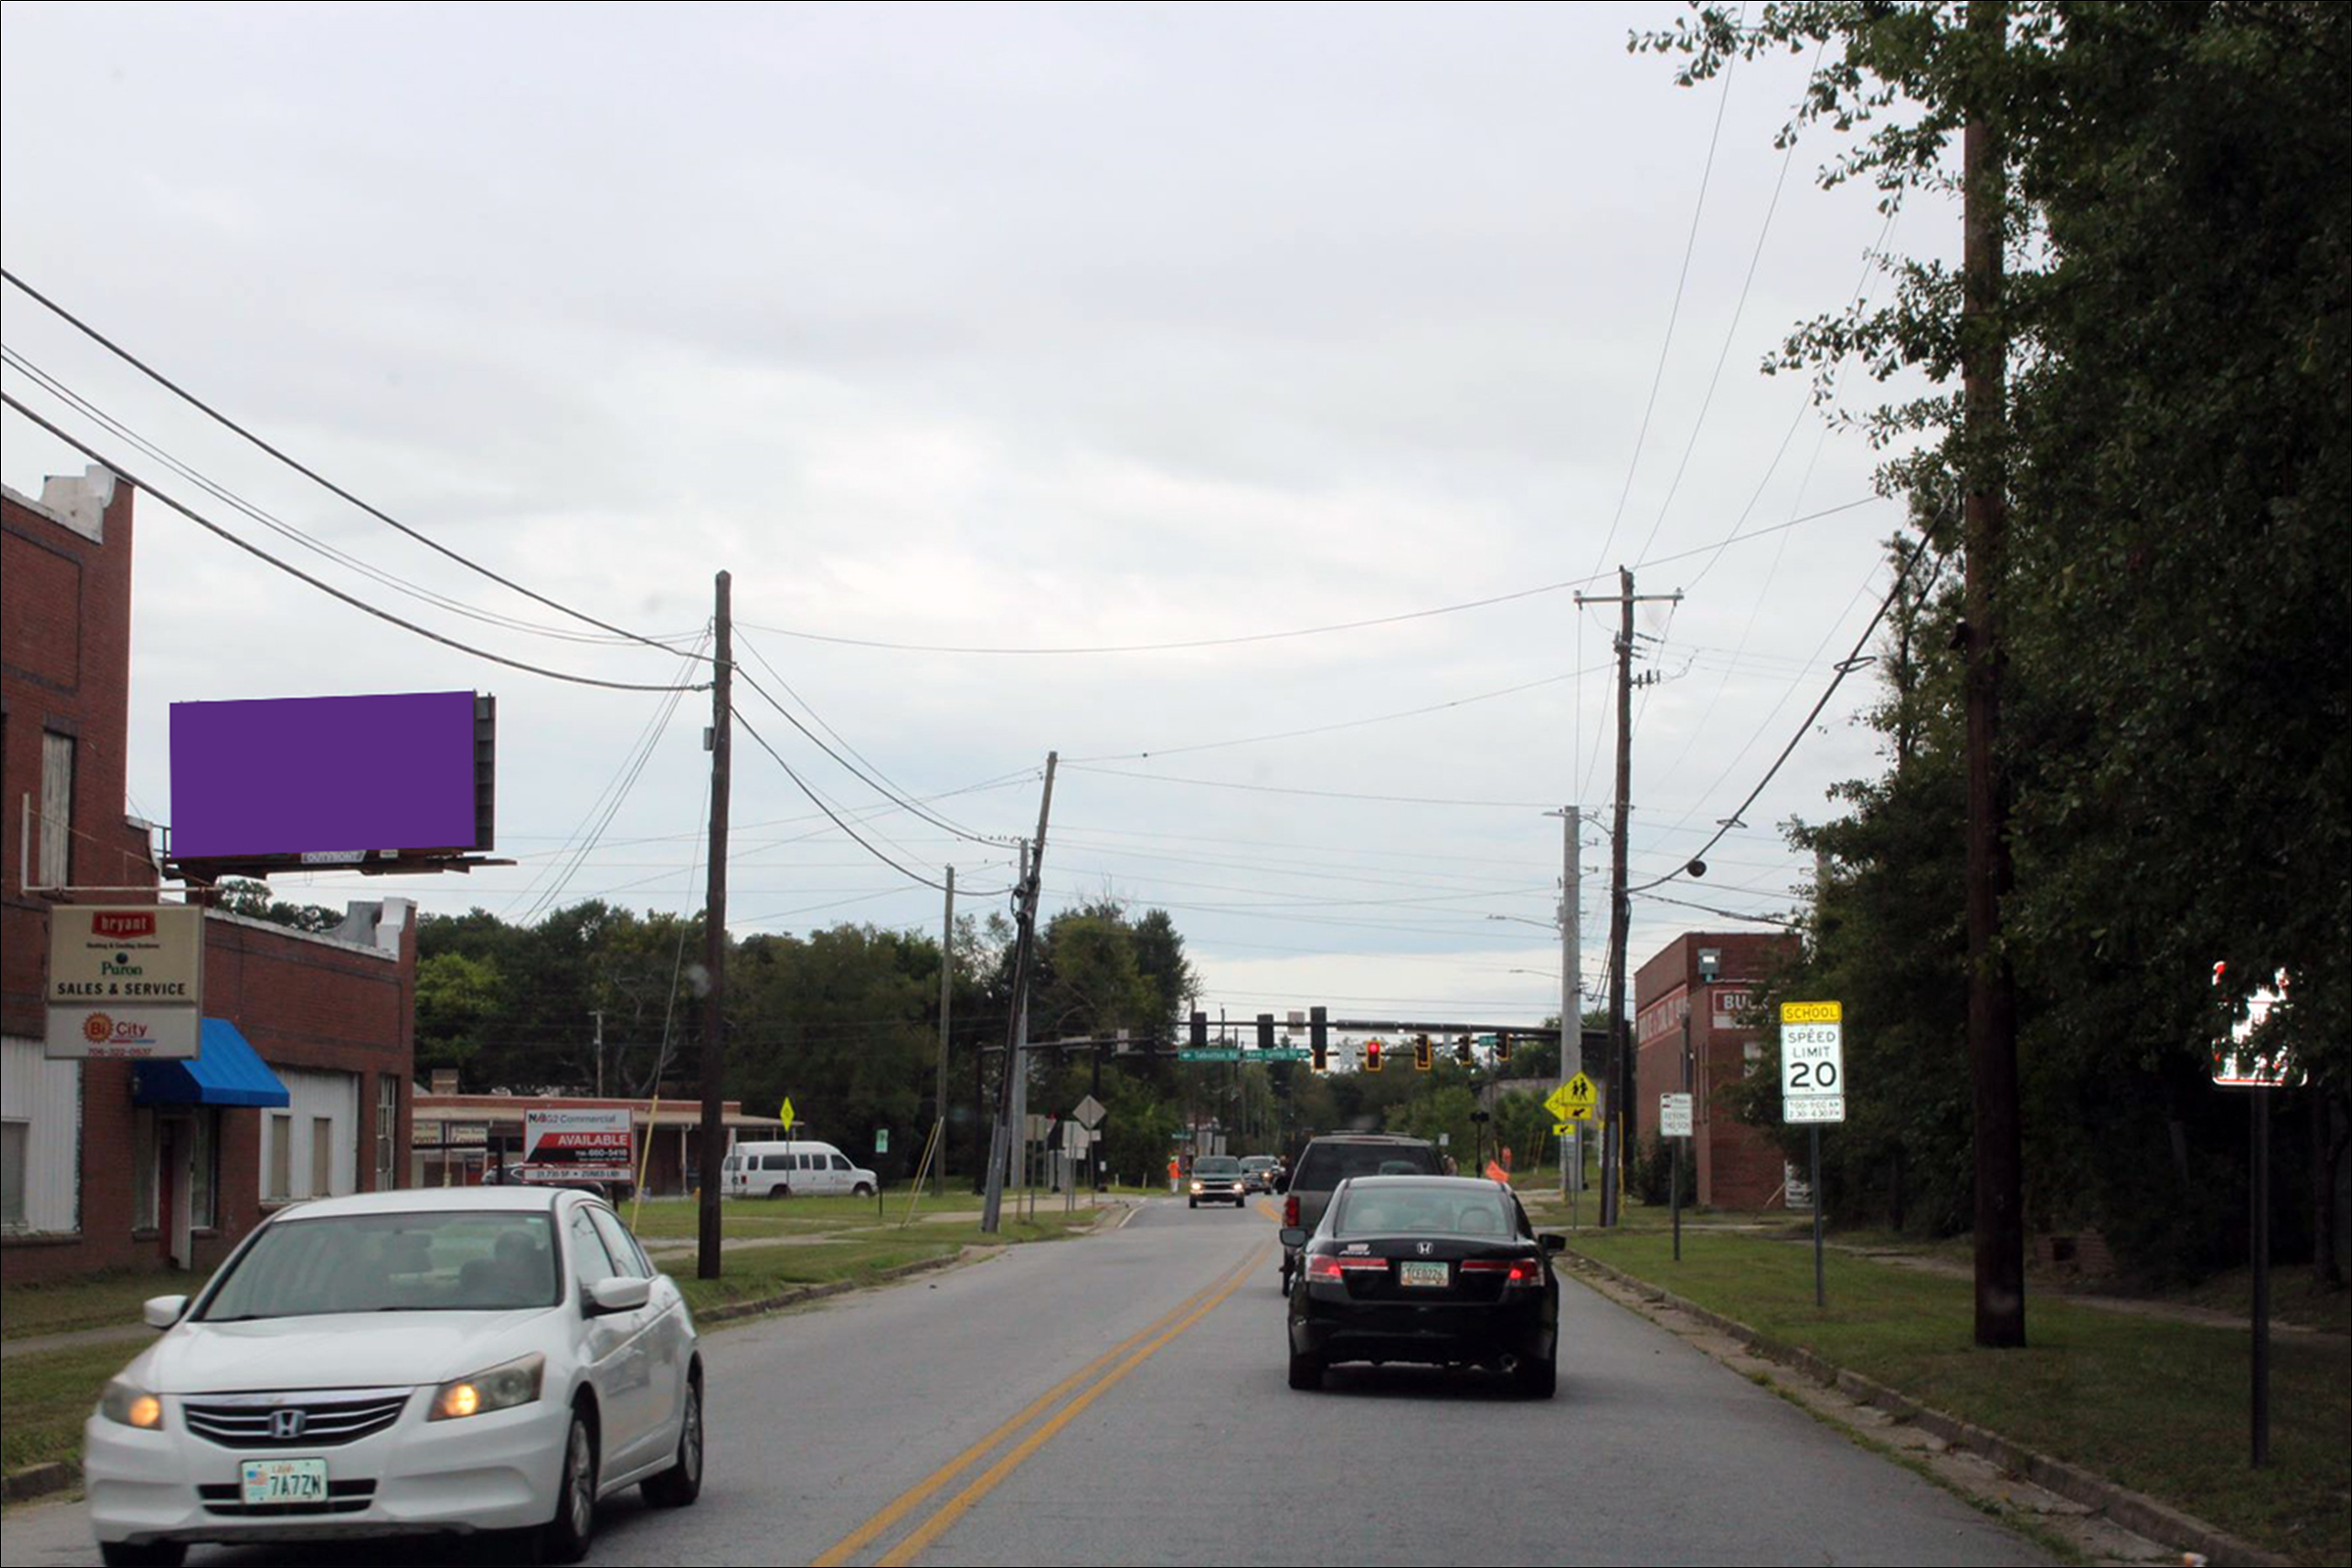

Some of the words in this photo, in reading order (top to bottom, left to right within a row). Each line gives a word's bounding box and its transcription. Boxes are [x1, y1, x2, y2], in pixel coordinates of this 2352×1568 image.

[101, 916, 147, 932] bryant
[102, 960, 142, 975] Puron
[58, 983, 103, 995] SALES
[109, 983, 119, 995] &
[124, 983, 185, 995] SERVICE
[1786, 1007, 1837, 1018] SCHOOL
[90, 1022, 105, 1035] Bi
[117, 1022, 147, 1037] City
[1788, 1031, 1836, 1043] SPEED
[1792, 1047, 1831, 1058] LIMIT
[1789, 1061, 1837, 1088] 20
[561, 1114, 615, 1123] Commercial
[558, 1135, 627, 1146] AVAILABLE
[270, 1474, 321, 1496] 7A7ZN
